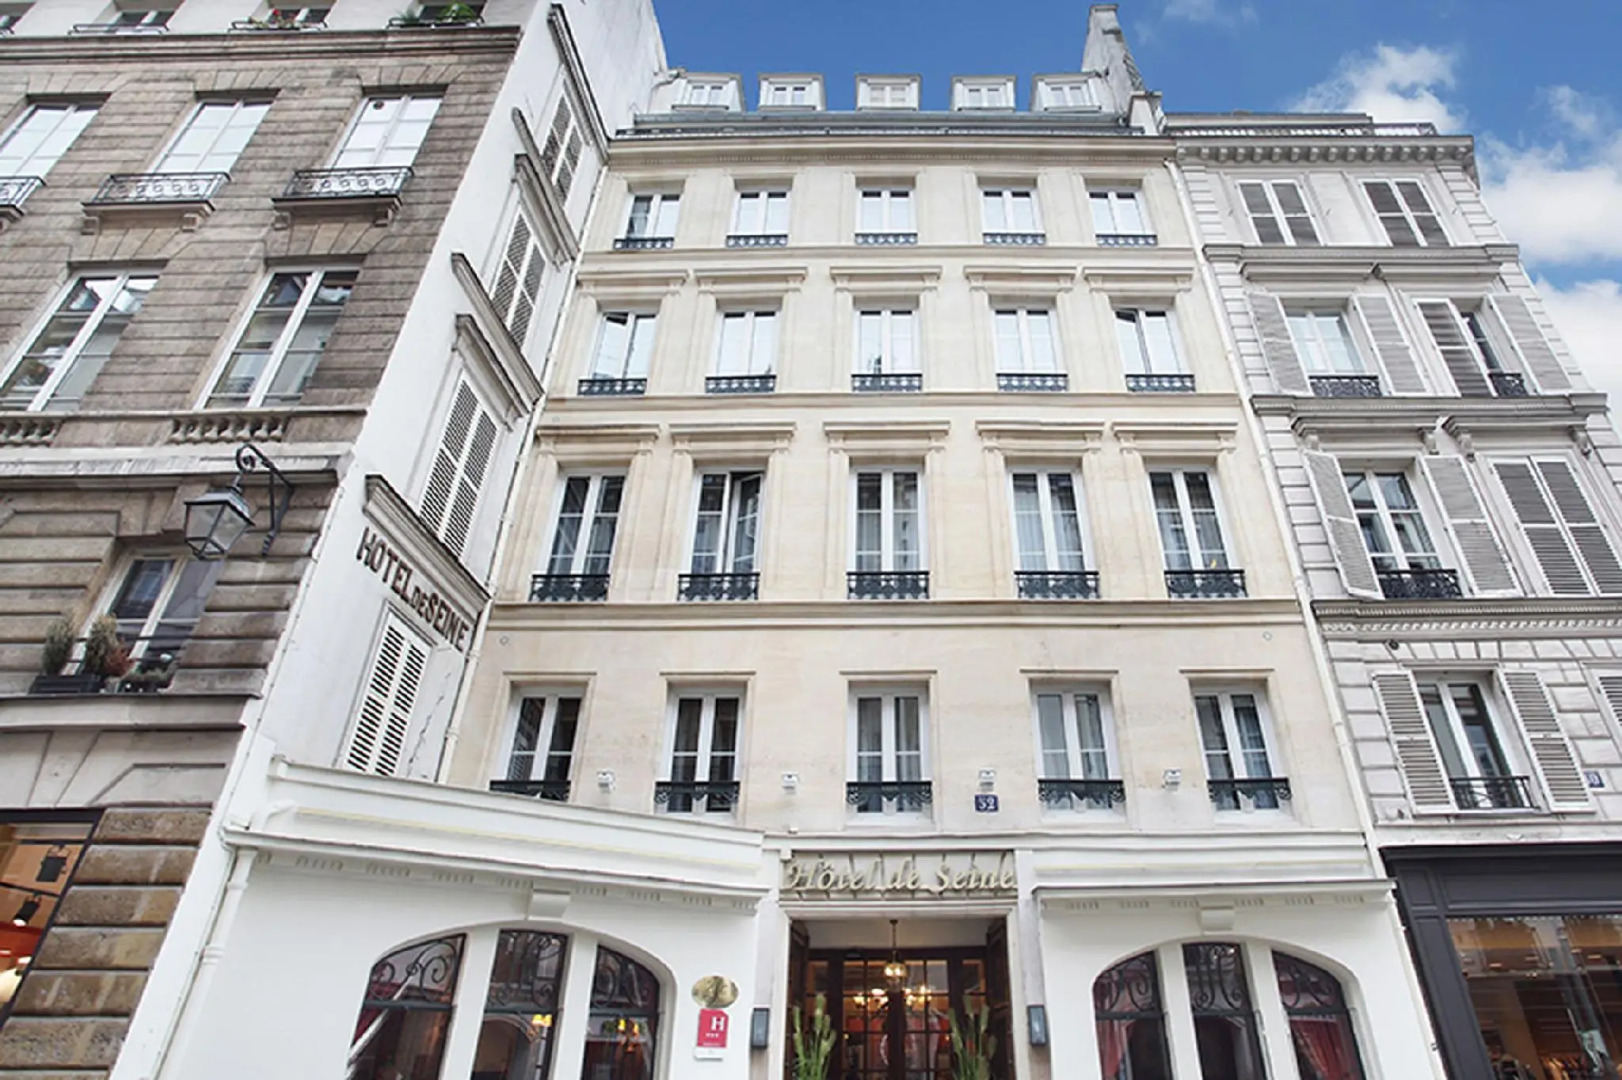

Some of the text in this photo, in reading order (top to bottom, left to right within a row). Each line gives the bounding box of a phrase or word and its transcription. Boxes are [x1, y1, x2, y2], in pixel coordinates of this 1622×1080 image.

[356, 526, 413, 604] HOTEL
[425, 592, 469, 653] SEINE
[783, 856, 1017, 893] Hôtel de Seine
[711, 1016, 725, 1031] H
